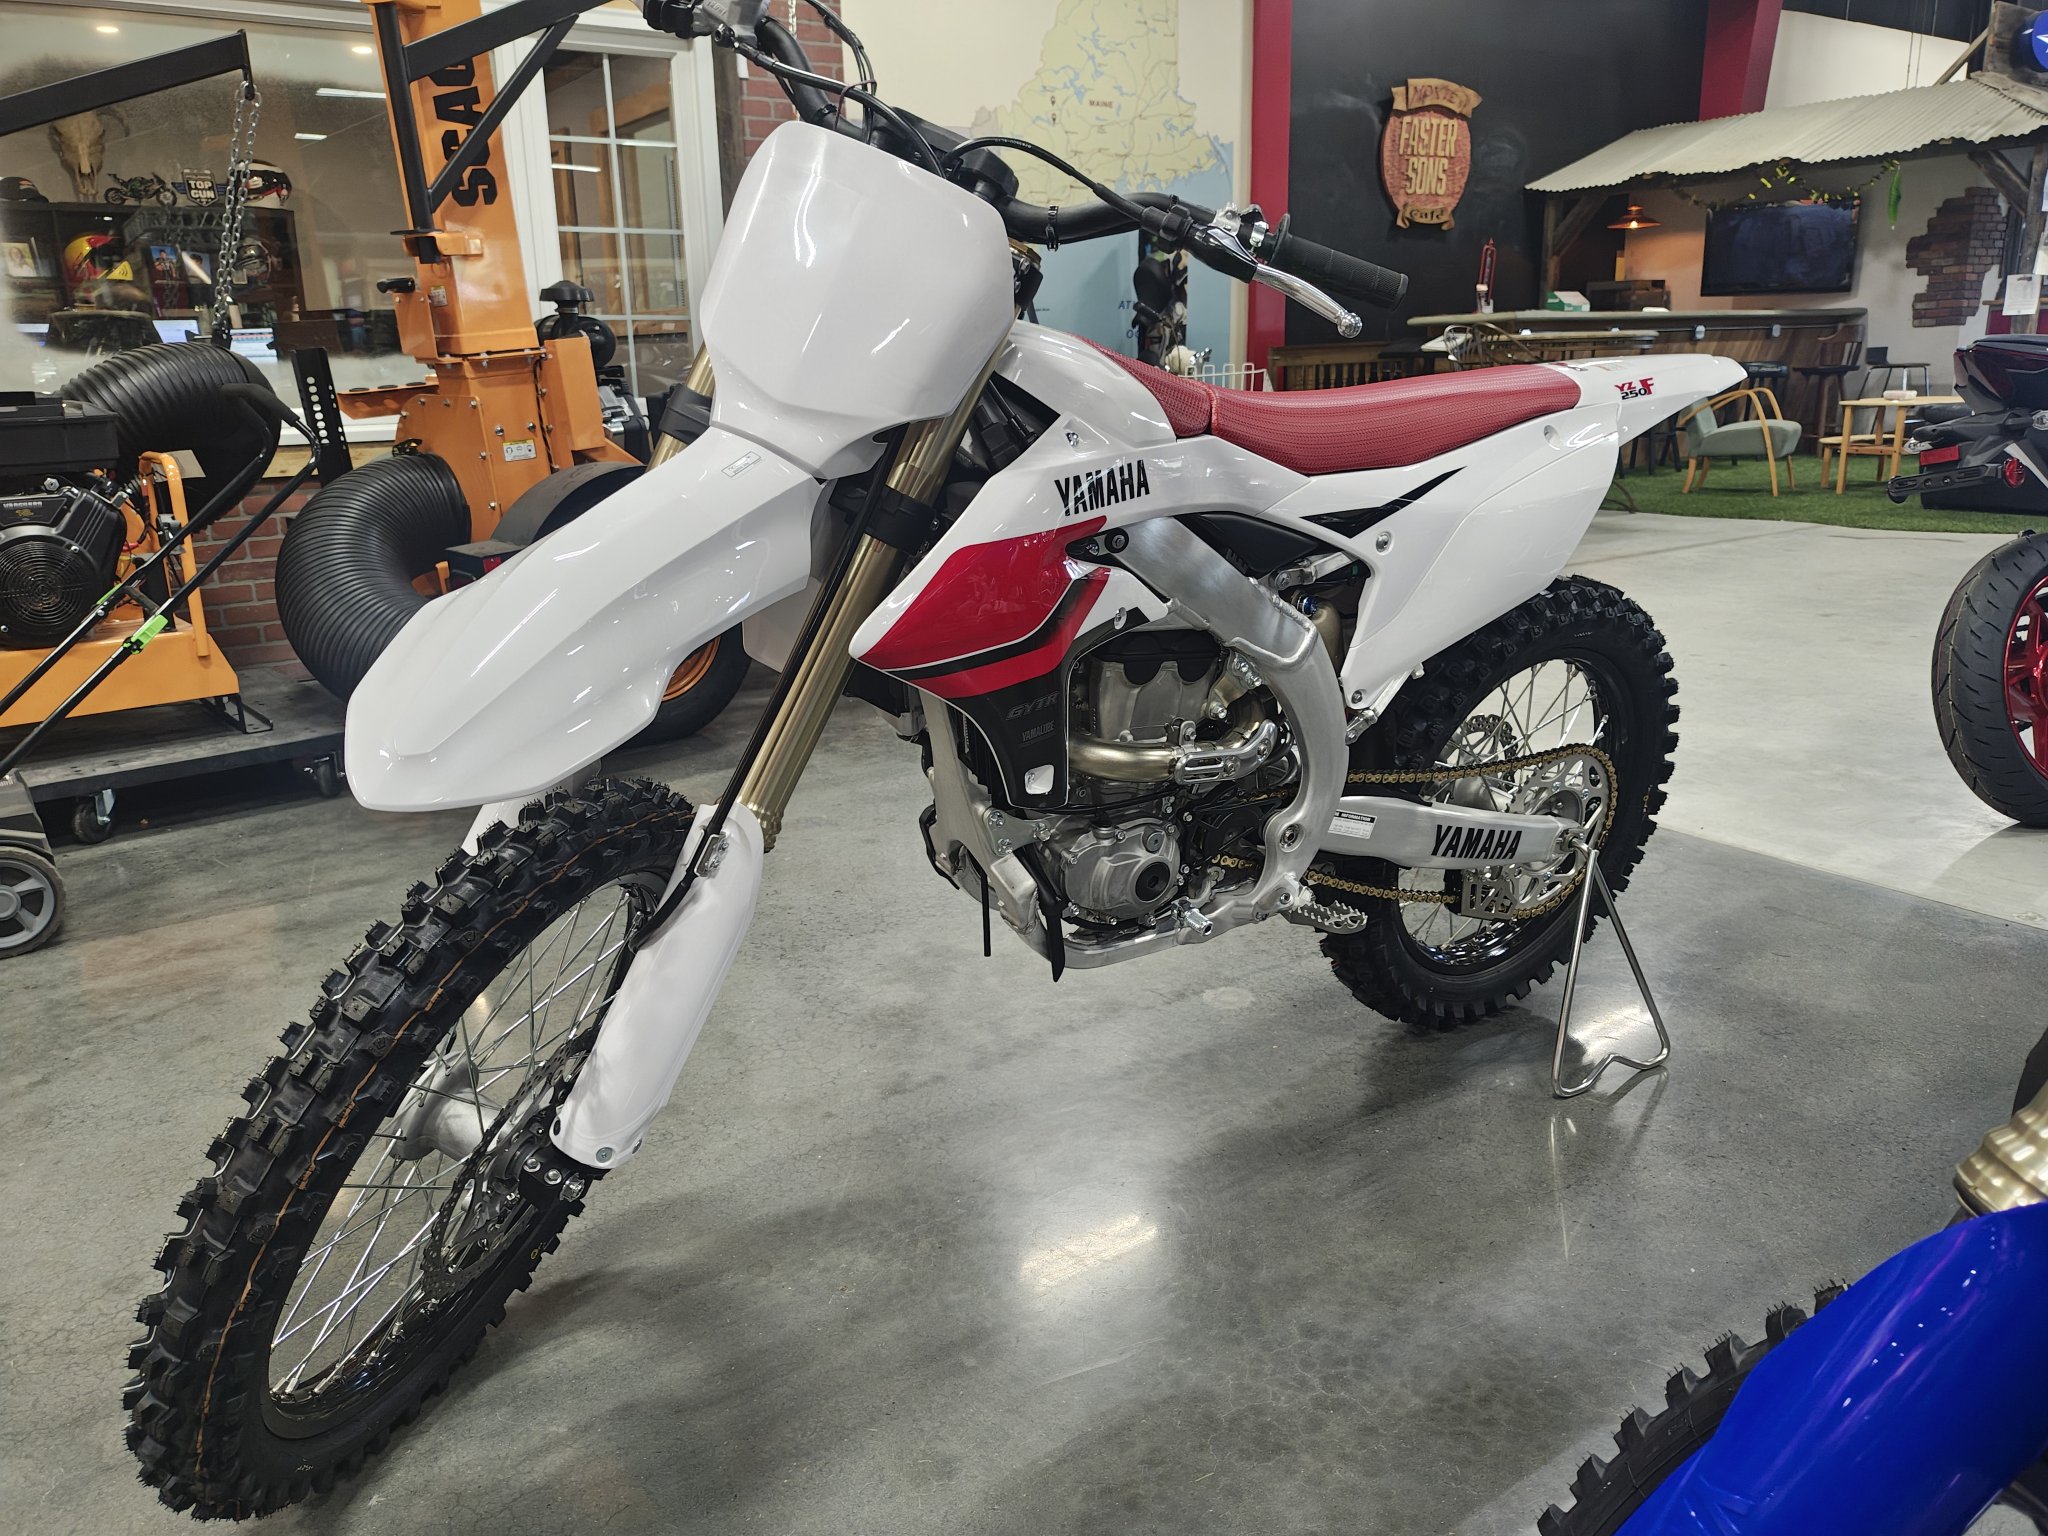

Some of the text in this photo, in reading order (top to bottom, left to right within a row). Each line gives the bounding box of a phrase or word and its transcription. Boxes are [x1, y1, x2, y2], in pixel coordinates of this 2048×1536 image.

[1089, 100, 1113, 108] MAINE
[1400, 116, 1458, 156] FASTER
[188, 180, 212, 189] TOP
[1406, 157, 1448, 195] SONS
[190, 189, 215, 199] GUN
[1614, 382, 1636, 392] YZ
[1054, 459, 1150, 516] YAMAHA
[1005, 690, 1060, 720] GYTR
[1431, 824, 1522, 859] YAMAHA
